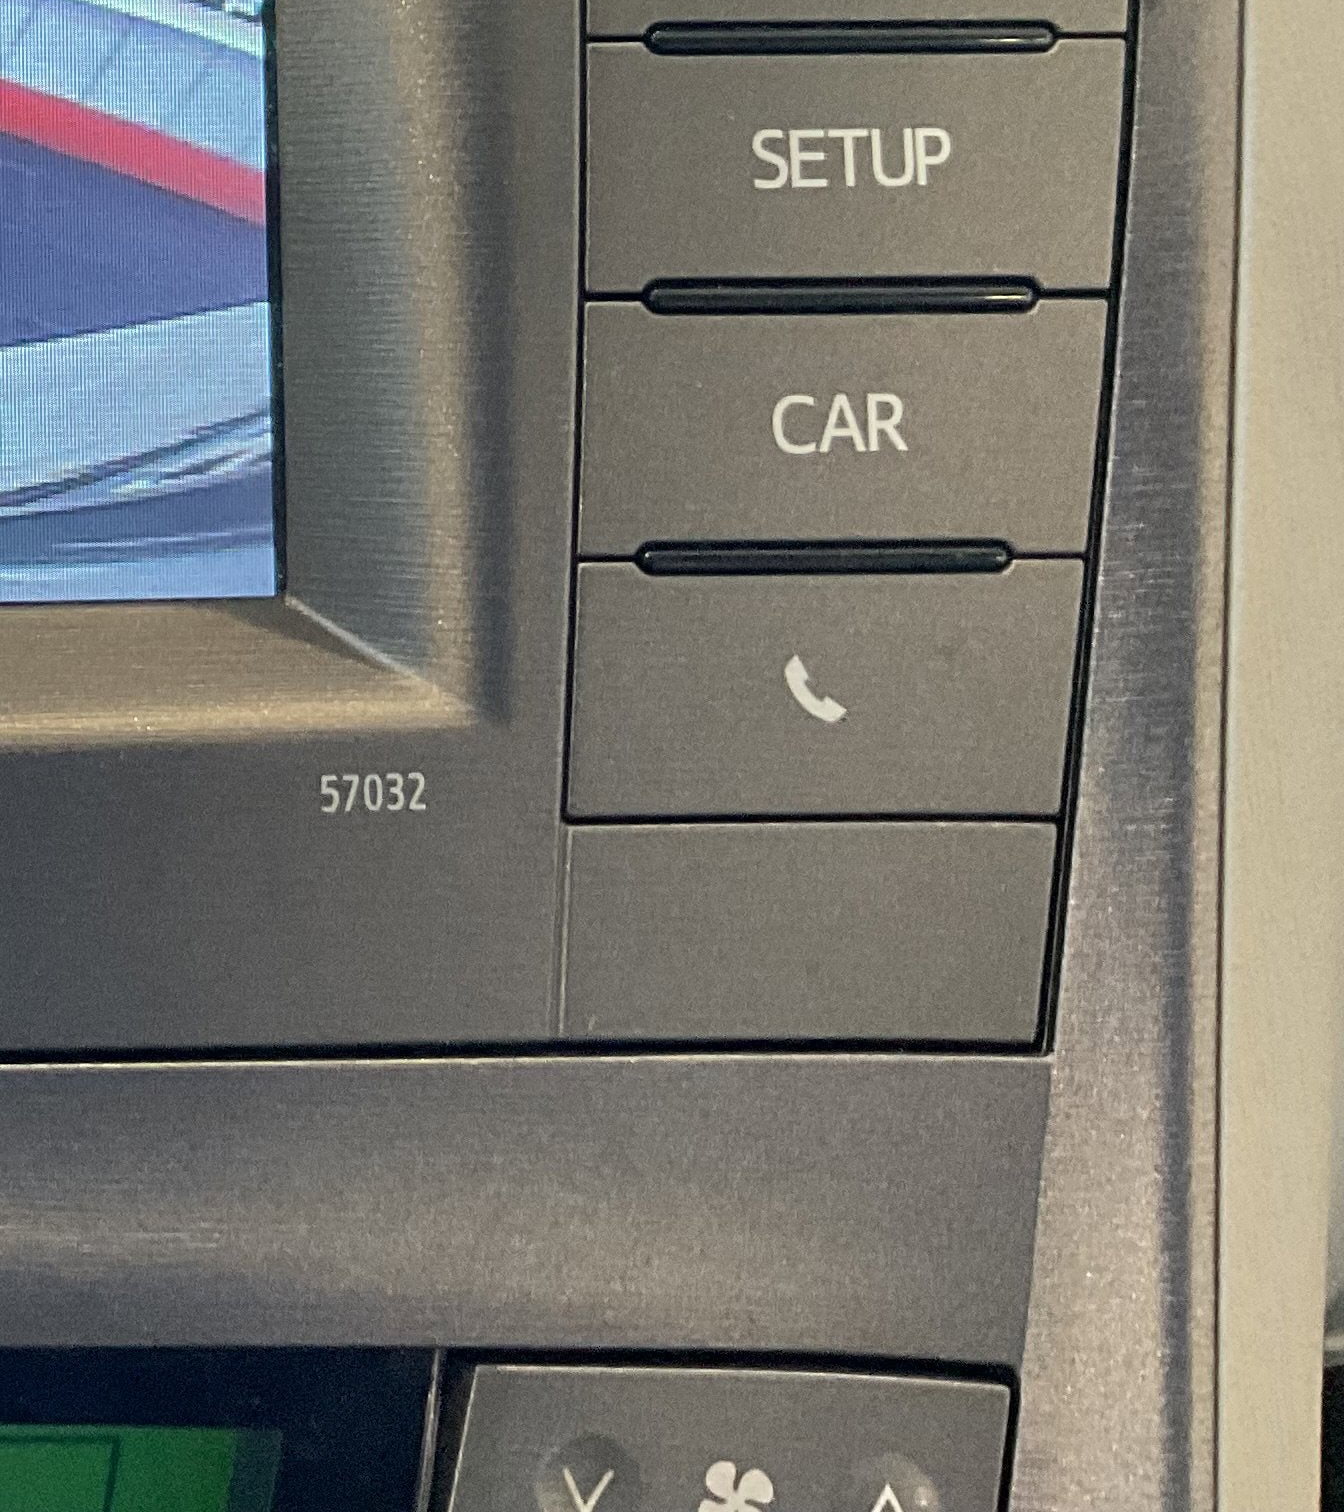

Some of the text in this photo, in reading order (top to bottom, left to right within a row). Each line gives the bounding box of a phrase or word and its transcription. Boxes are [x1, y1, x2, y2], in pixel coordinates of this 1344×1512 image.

[752, 127, 951, 189] SETUP
[771, 392, 909, 455] CAR
[320, 771, 427, 813] 57032
